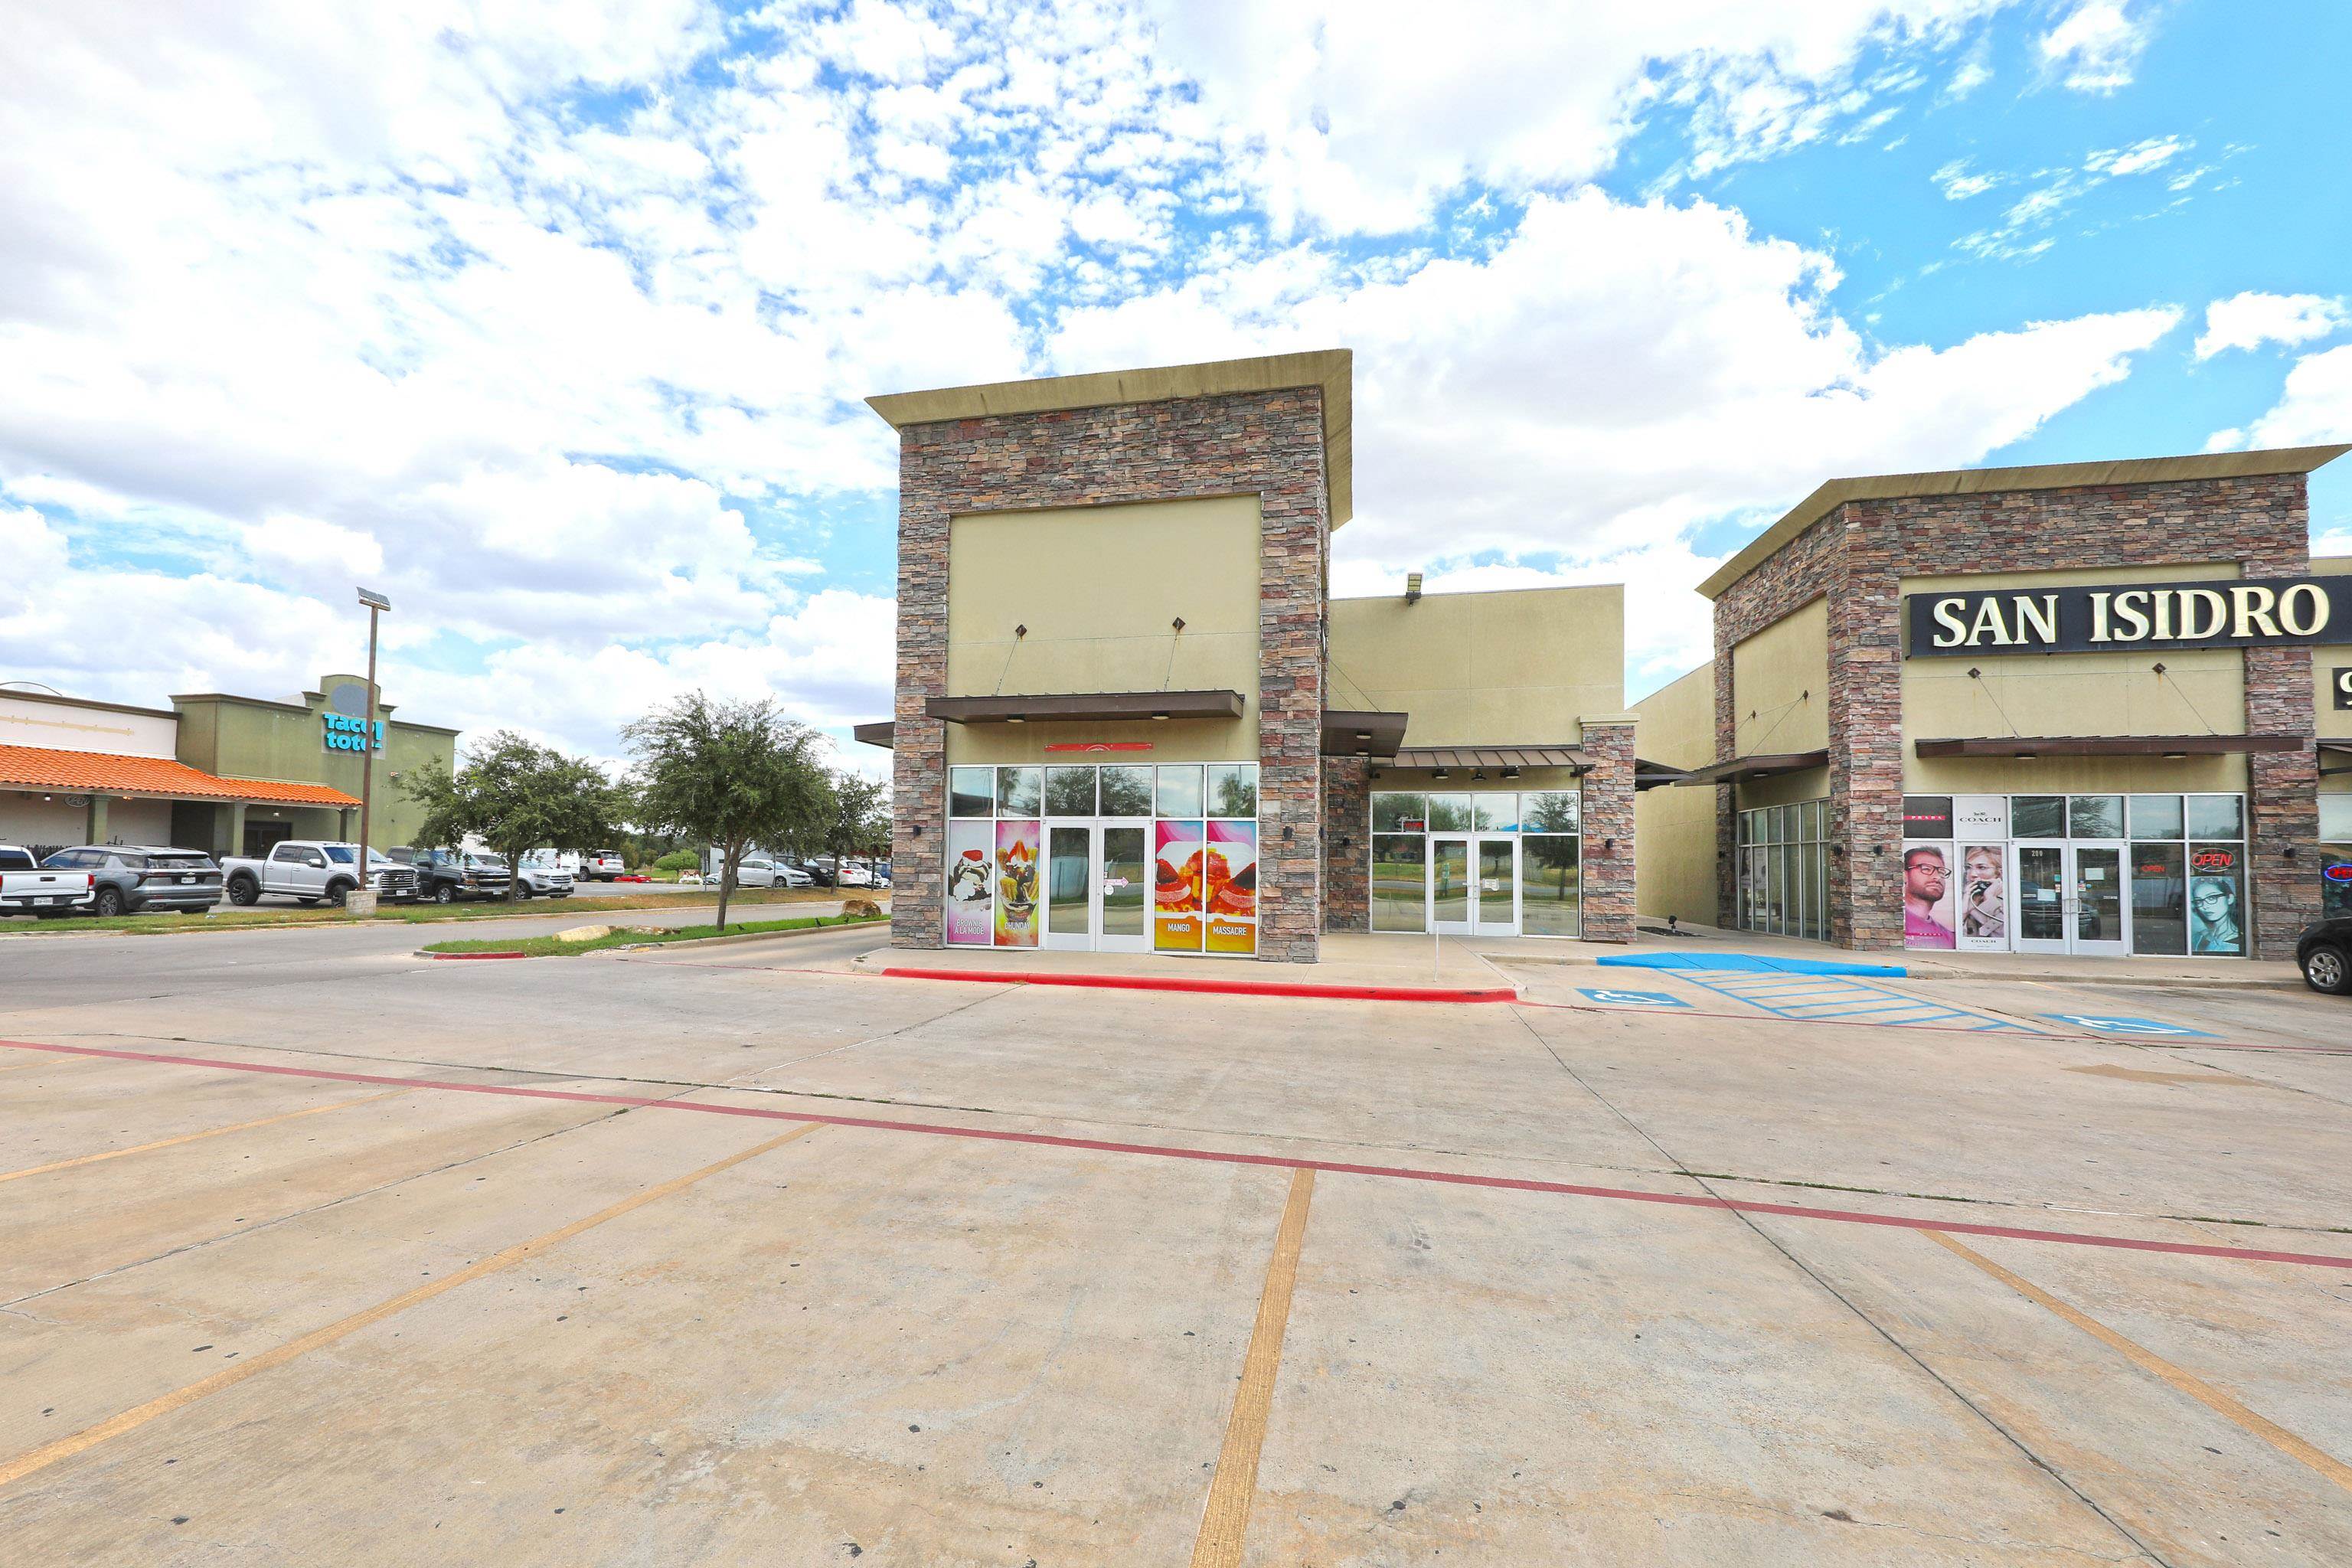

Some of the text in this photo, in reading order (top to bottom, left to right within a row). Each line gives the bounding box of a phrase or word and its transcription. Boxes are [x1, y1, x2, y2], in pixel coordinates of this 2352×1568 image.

[1933, 583, 2331, 647] SAN ISIDRO
[2192, 853, 2233, 867] OPEN
[2141, 864, 2166, 873] OPEN
[956, 919, 982, 927] BROWNIE
[1004, 922, 1031, 930] CHUNDAY
[1168, 923, 1247, 936] MANGO MASSACRE
